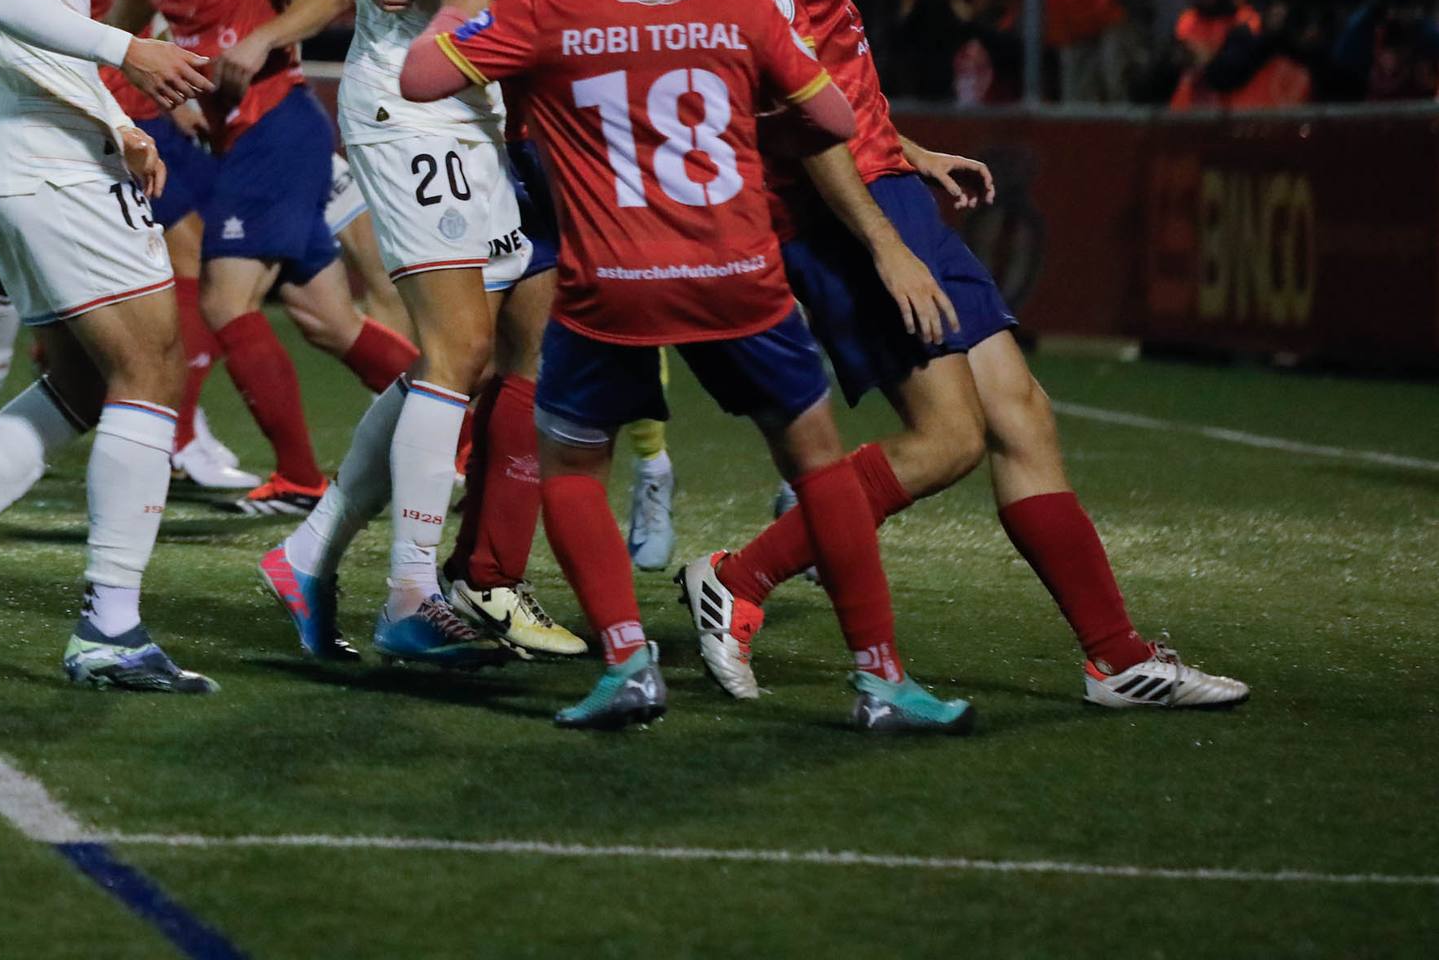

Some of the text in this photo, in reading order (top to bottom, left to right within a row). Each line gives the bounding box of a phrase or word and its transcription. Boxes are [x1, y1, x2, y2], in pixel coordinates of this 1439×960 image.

[562, 22, 748, 56] ROBI TORAL
[570, 66, 745, 208] 18
[411, 150, 471, 207] 20
[402, 508, 444, 526] 1928
